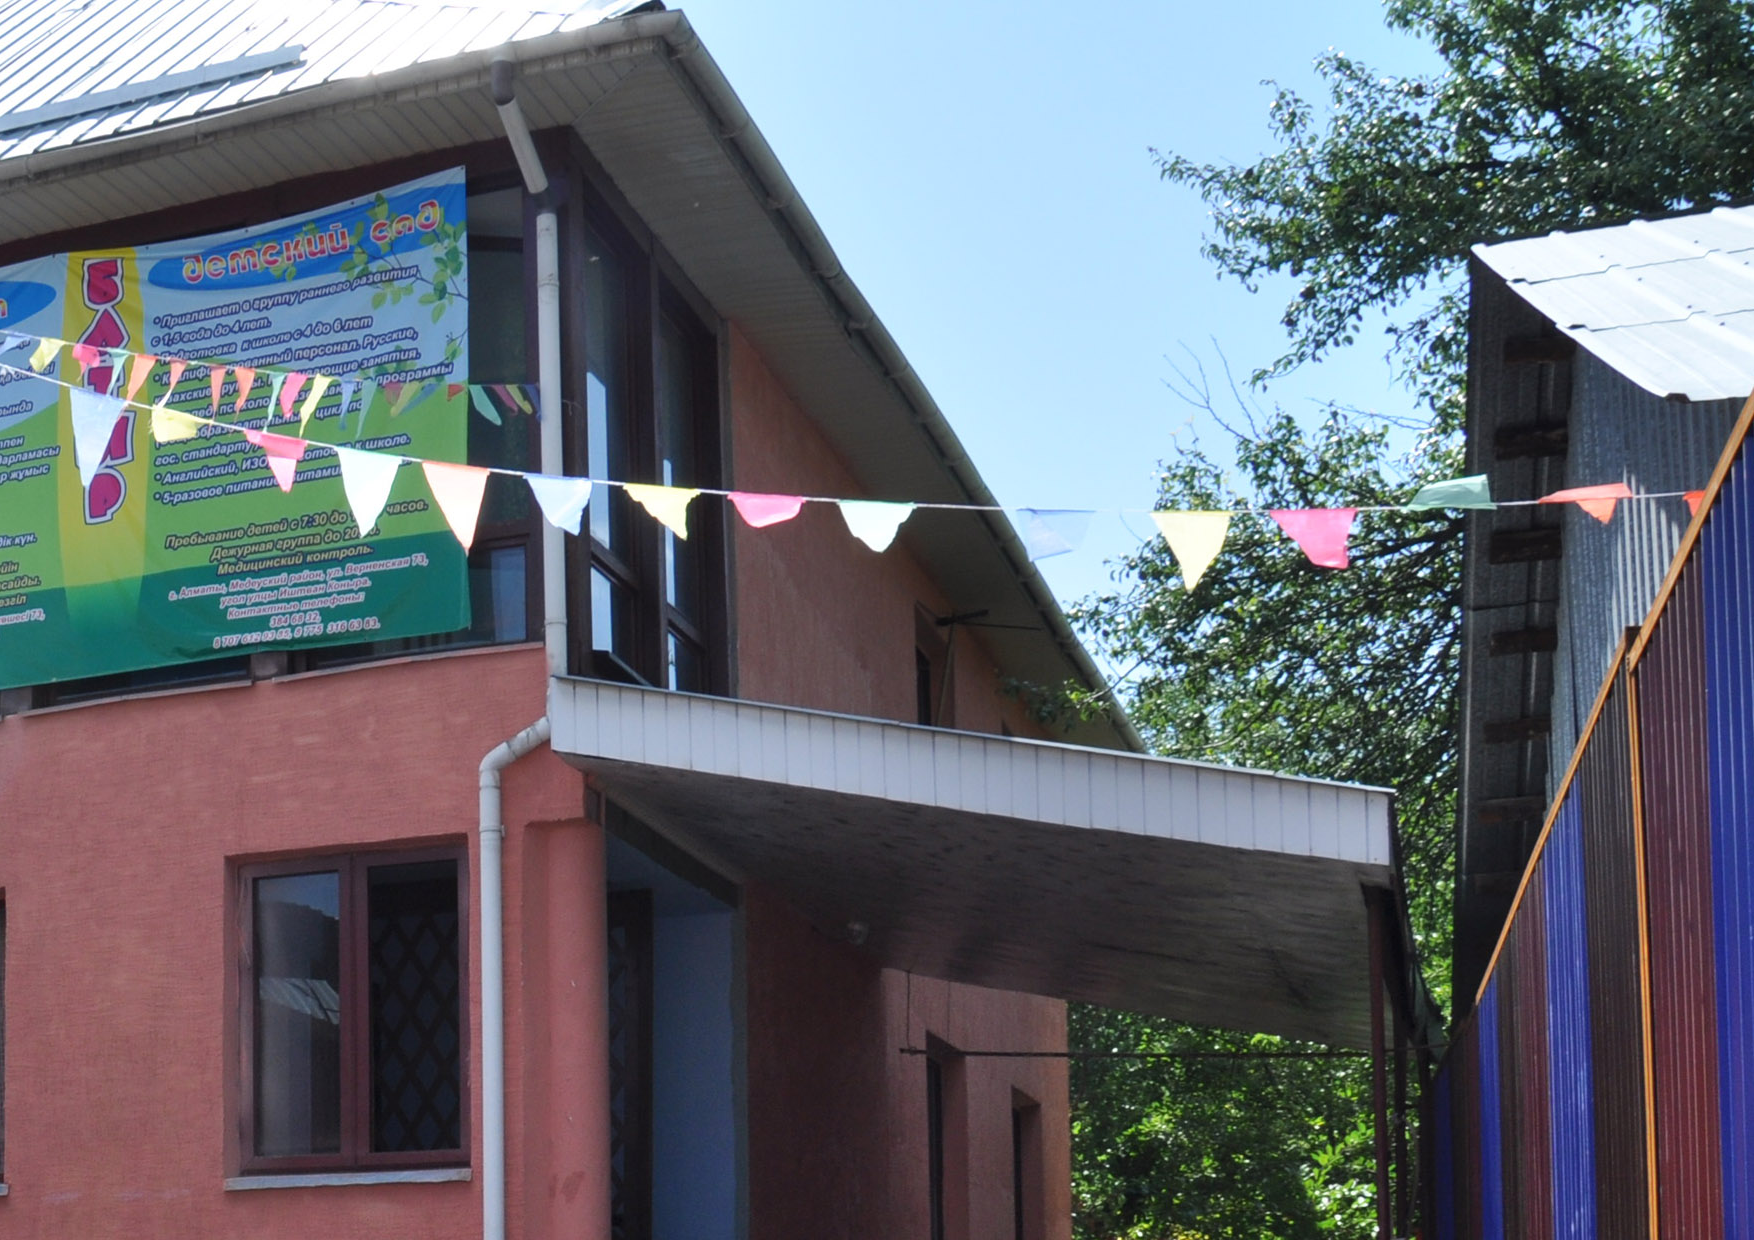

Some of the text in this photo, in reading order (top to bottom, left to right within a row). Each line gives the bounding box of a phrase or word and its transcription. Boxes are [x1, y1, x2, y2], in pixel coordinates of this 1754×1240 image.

[182, 199, 440, 284] детский сад
[161, 267, 418, 327] Приглашает группу раннего развития
[163, 319, 272, 346] 1,5 года до 4 лет.
[252, 333, 290, 348] школе
[303, 324, 312, 337] 4
[314, 323, 330, 335] до
[334, 319, 342, 332] 6
[344, 317, 372, 329] лет
[296, 329, 418, 359] персонал. Русские,
[361, 350, 420, 367] занятия.
[376, 364, 453, 386] программы
[156, 455, 179, 466] гос.
[162, 461, 238, 482] Английский,
[366, 435, 410, 448] школе.
[163, 486, 222, 503] 5-разовое
[166, 528, 244, 549] Пребывание
[248, 518, 287, 535] детей
[302, 512, 327, 527] 7:30
[330, 510, 346, 523] до
[386, 501, 428, 514] часов.
[211, 530, 340, 559] Дежурная группа до
[179, 552, 429, 599] Алматы, Медеуский район, ул. Верненская 73,
[218, 547, 374, 575] Медицинский контроль.
[219, 594, 246, 610] угол
[278, 584, 326, 599] Иштван
[226, 589, 366, 620] Контактные телефоны:
[221, 633, 242, 648] 707
[240, 631, 260, 645] 612
[261, 629, 276, 642] 93
[302, 622, 324, 636] 775
[326, 619, 346, 634] 316
[348, 617, 362, 631] 63
[269, 613, 288, 628] 384
[290, 610, 304, 624] 68
